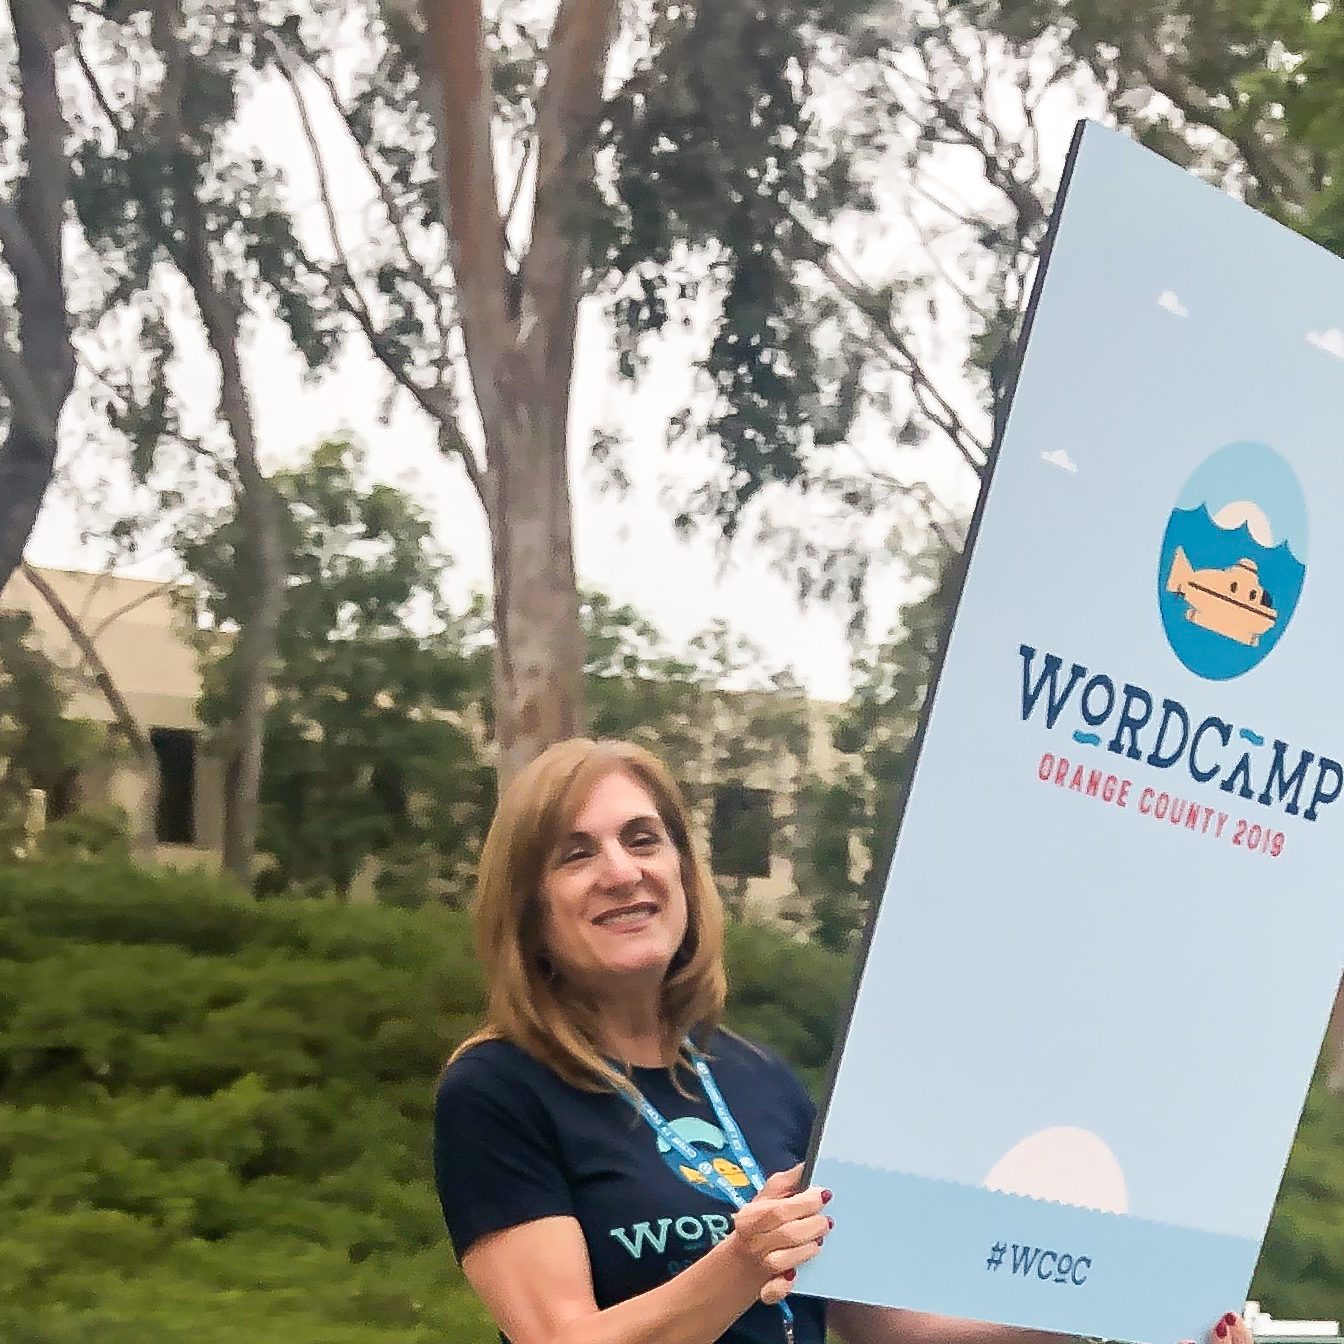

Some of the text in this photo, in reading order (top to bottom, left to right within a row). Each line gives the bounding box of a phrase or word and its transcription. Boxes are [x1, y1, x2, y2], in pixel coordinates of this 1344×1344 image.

[1019, 645, 1344, 821] WORDCAMP
[1038, 752, 1287, 858] ORANGE COUNTY 2019
[610, 1214, 736, 1258] WOR
